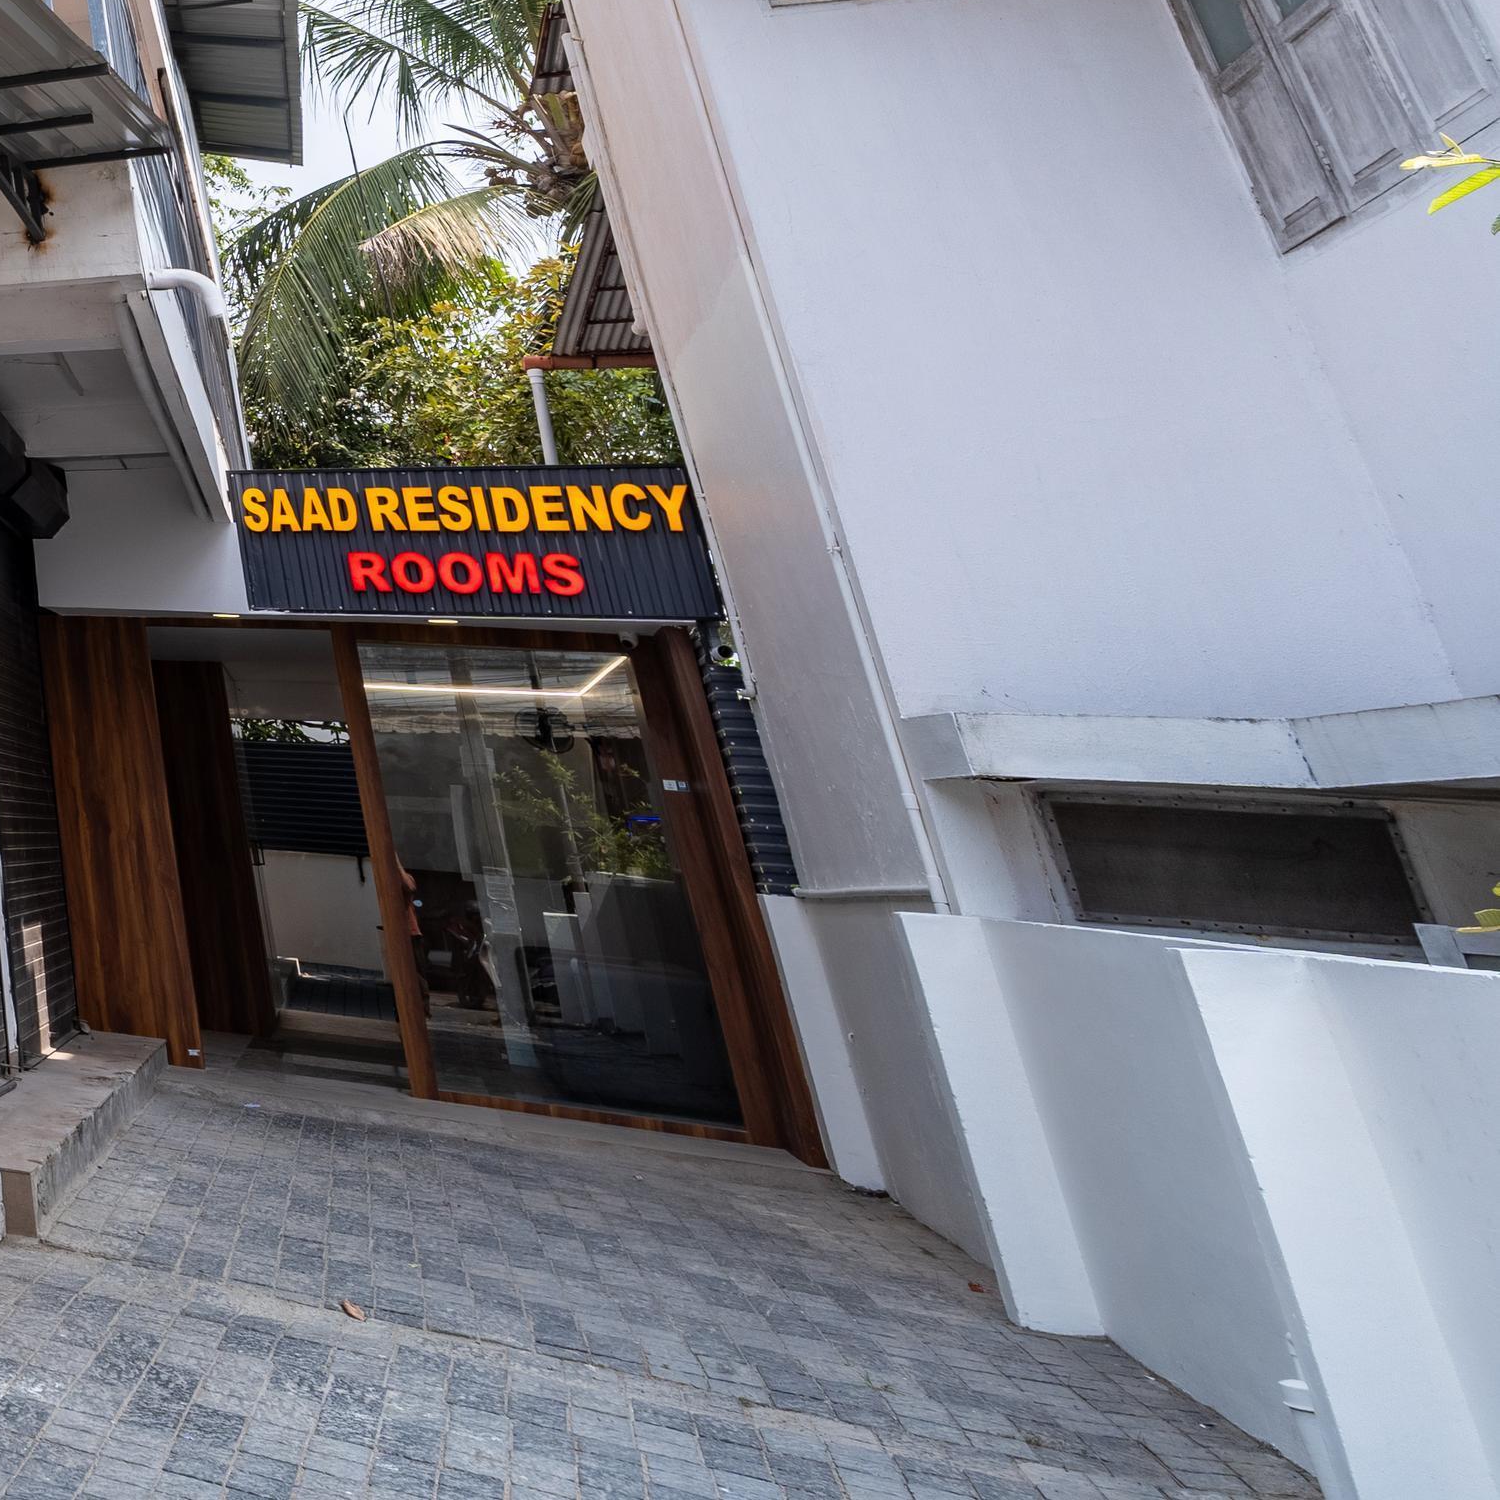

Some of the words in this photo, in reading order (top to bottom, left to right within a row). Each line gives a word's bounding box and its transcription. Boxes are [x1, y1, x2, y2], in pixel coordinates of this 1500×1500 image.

[241, 485, 358, 533] SAAD
[364, 482, 688, 533] RESIDENCY
[347, 550, 586, 597] ROOMS
